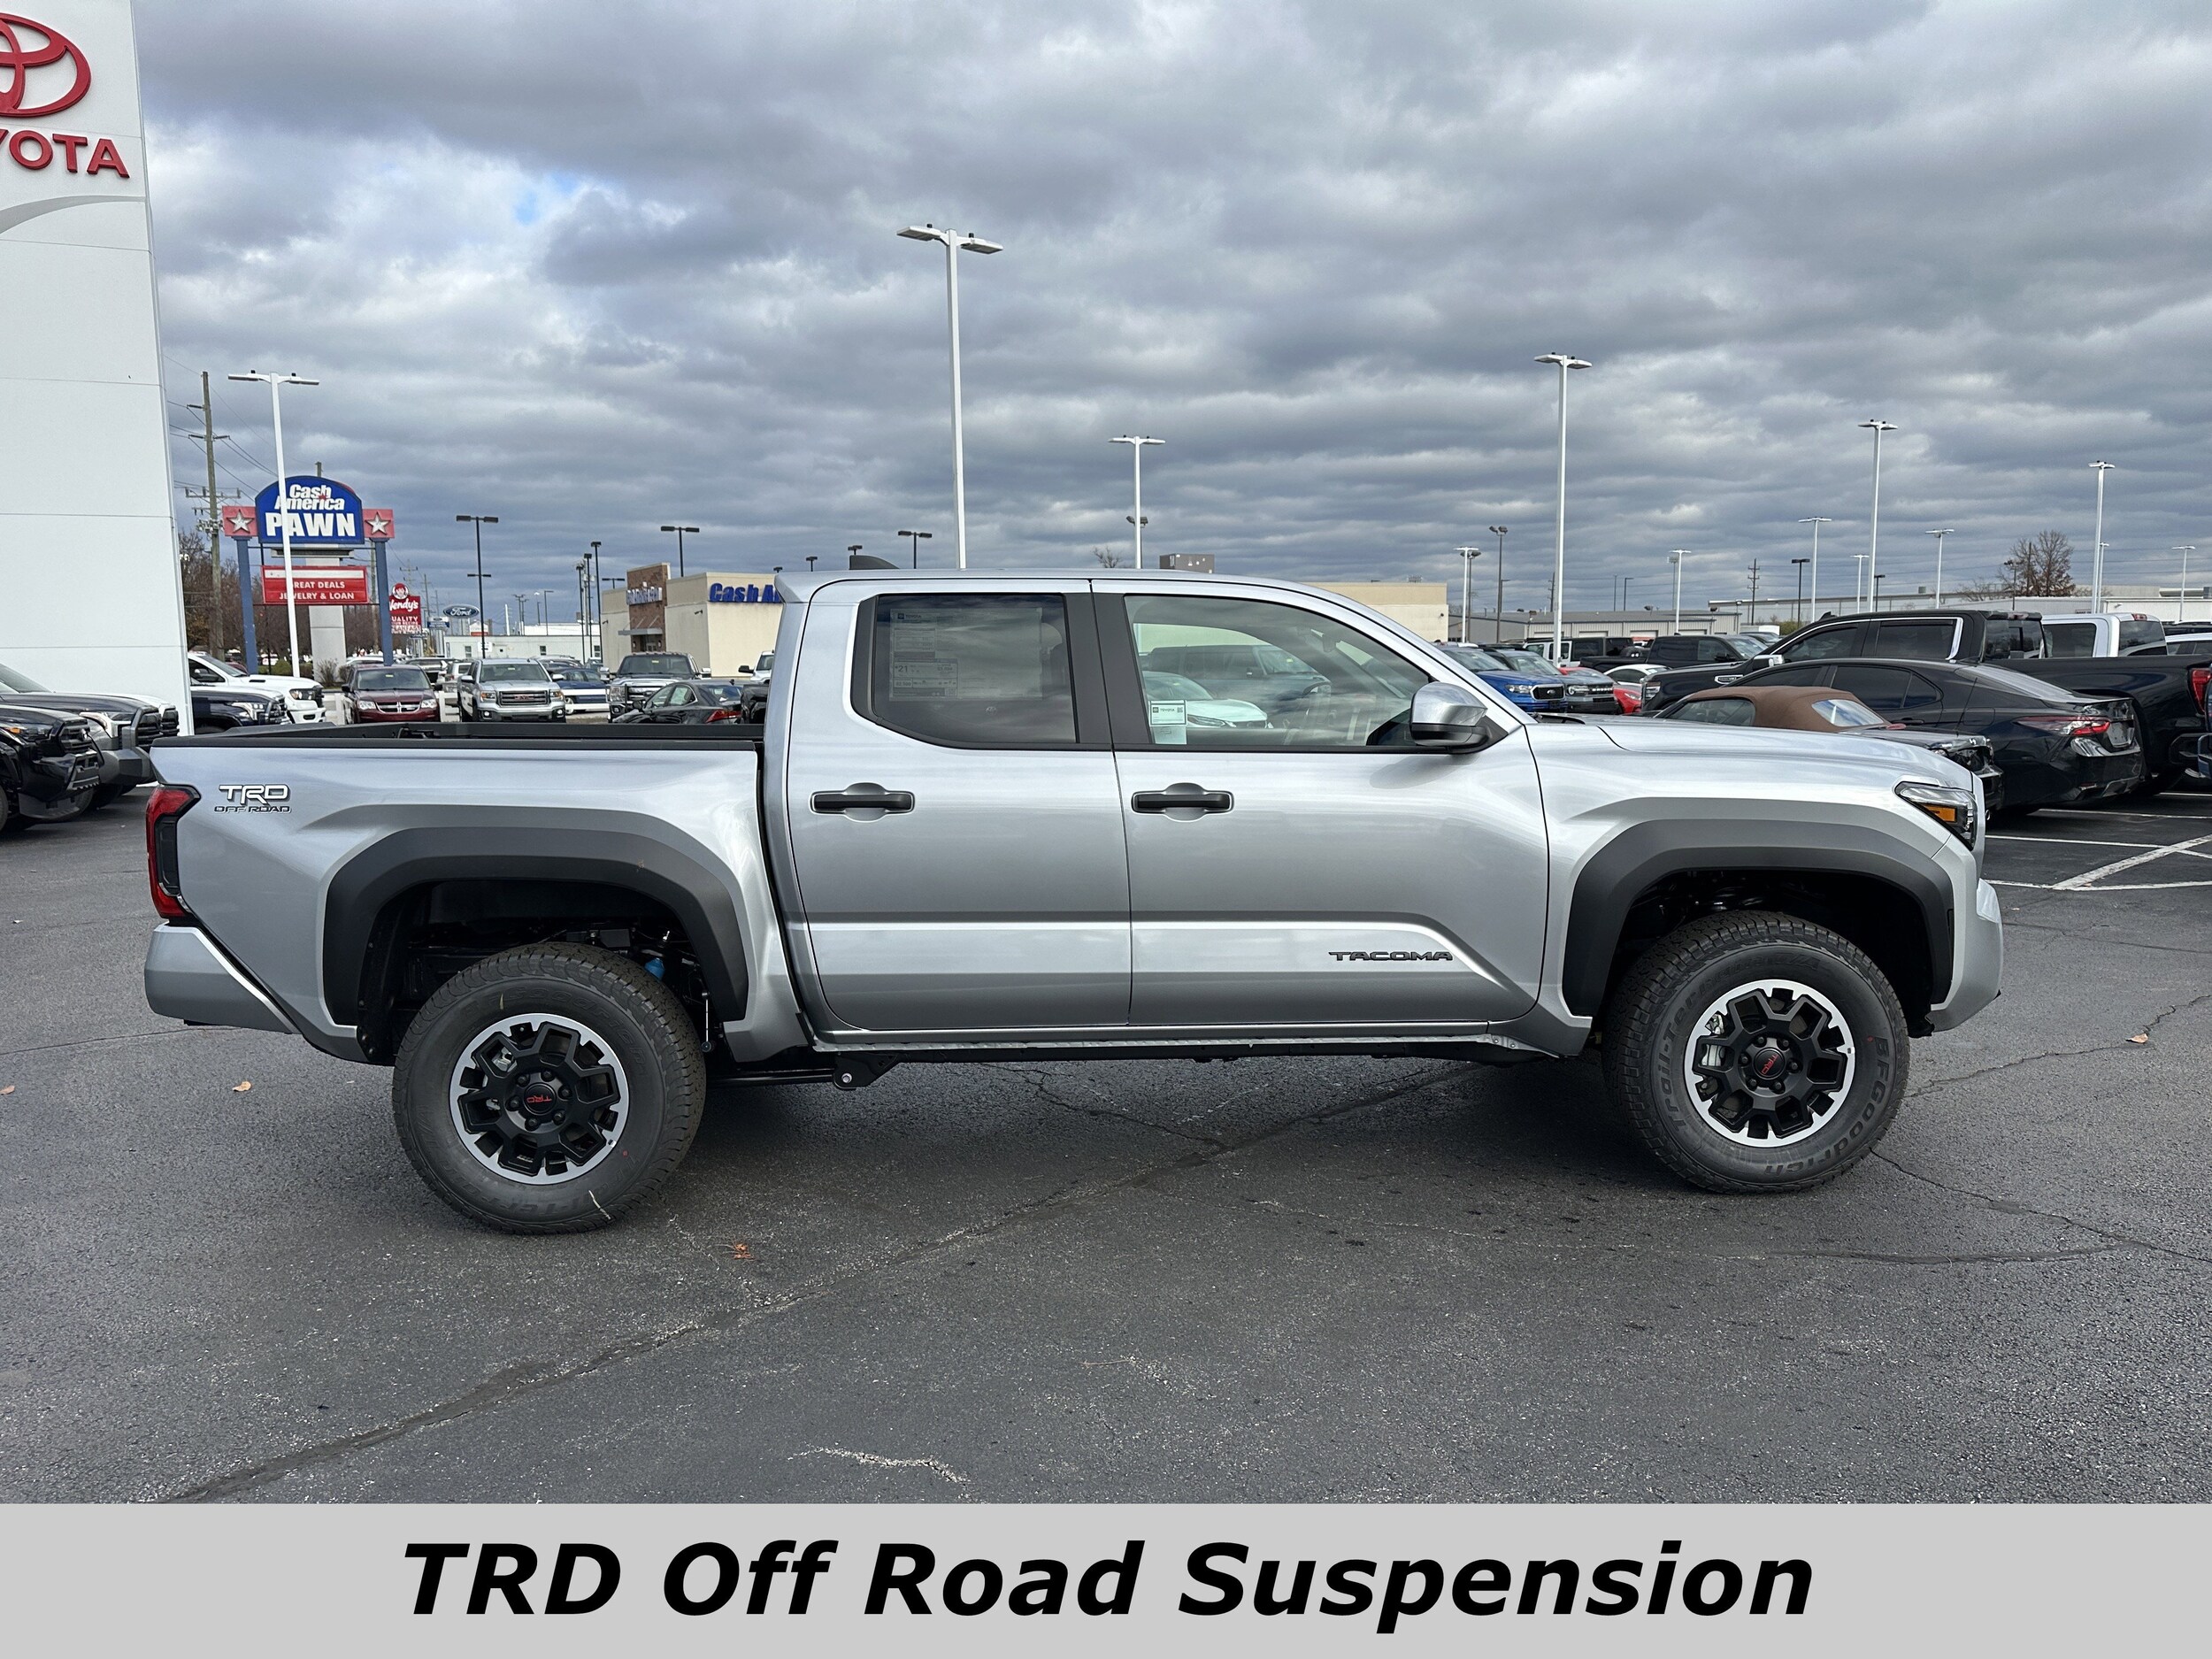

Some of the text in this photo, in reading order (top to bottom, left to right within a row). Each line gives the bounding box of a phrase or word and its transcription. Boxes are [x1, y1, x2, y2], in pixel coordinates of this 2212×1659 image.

[0, 128, 130, 179] OTA
[289, 484, 332, 498] Cash
[265, 512, 356, 537] PAWN
[710, 582, 759, 603] Cash
[449, 606, 472, 617] Ford
[219, 784, 290, 806] TRD
[1328, 951, 1454, 962] TACOMA
[1761, 1053, 1779, 1075] TRD
[526, 1094, 553, 1103] TRD
[1764, 1035, 1890, 1177] BFGoodrich
